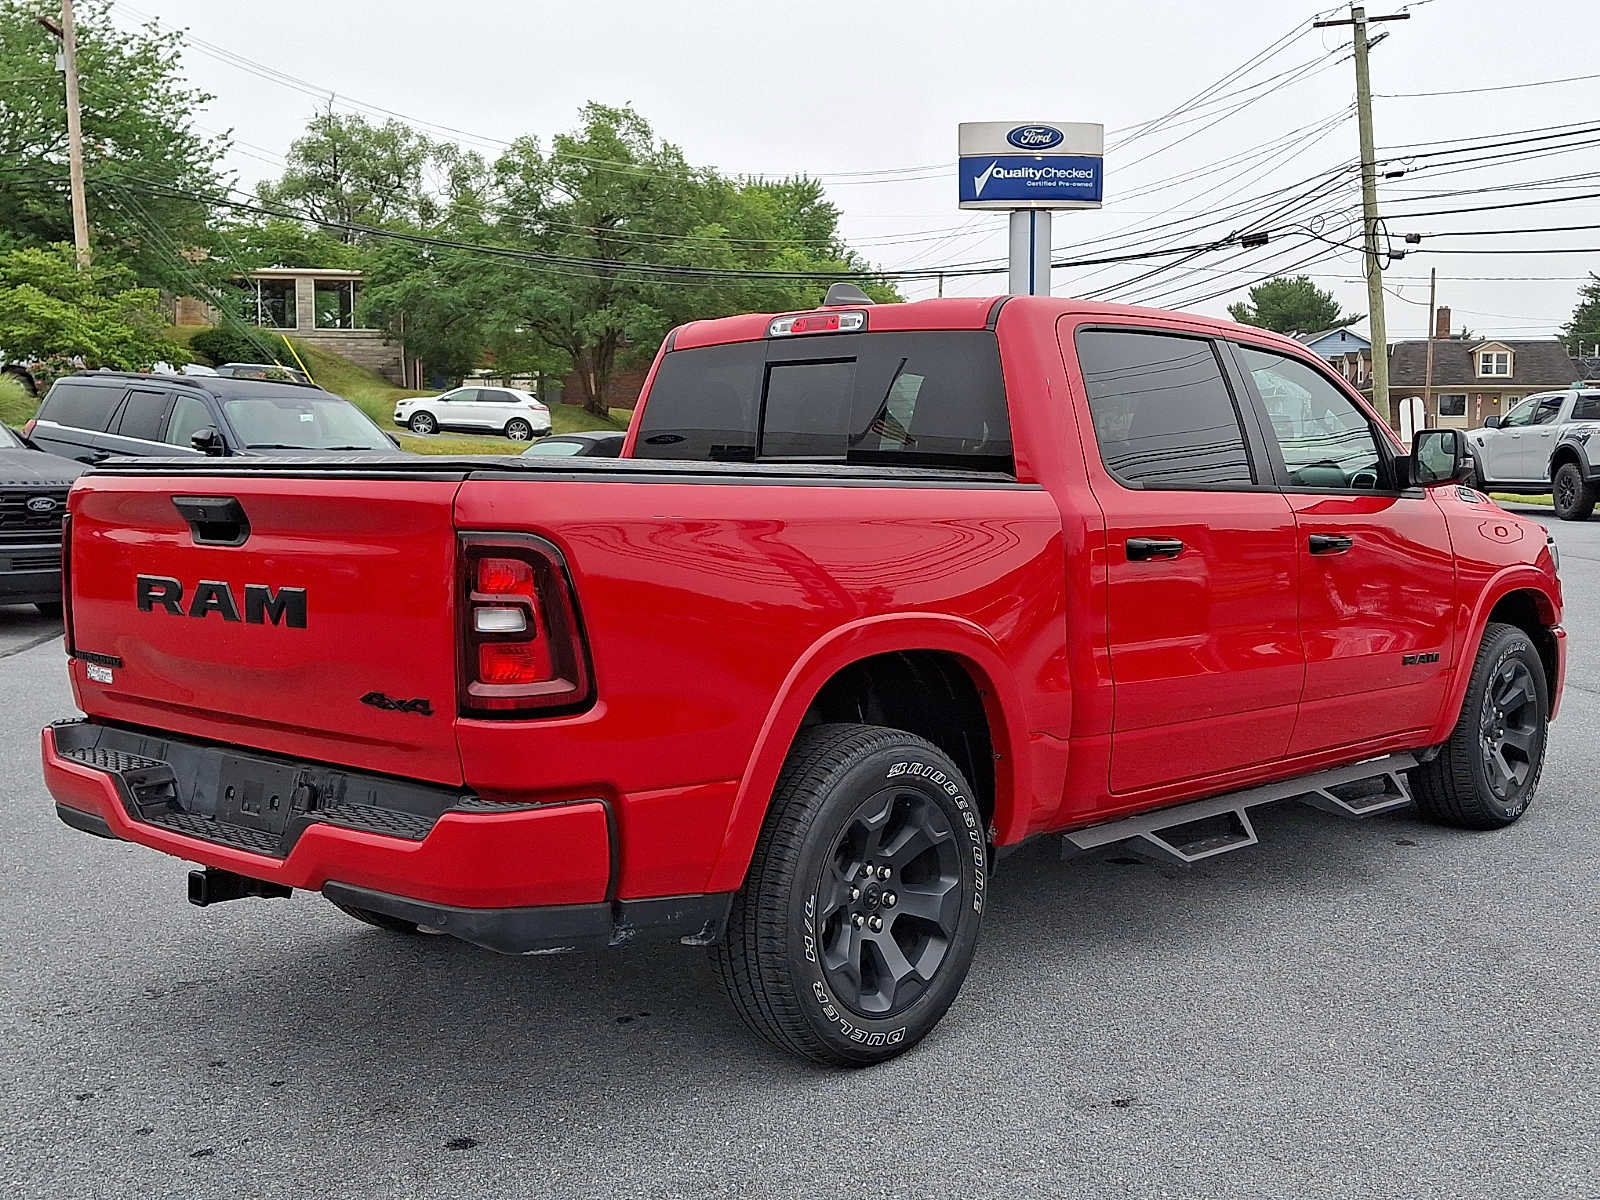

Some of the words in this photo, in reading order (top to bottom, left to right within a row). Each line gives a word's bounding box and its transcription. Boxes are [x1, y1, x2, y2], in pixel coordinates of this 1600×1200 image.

[1020, 128, 1053, 144] Ford
[992, 167, 1093, 180] QualityChecked
[137, 573, 307, 629] RAM
[1402, 653, 1439, 665] RAM
[886, 762, 985, 914] BRIDGESTONE
[804, 894, 816, 963] H/T
[812, 980, 907, 1046] DUELER
